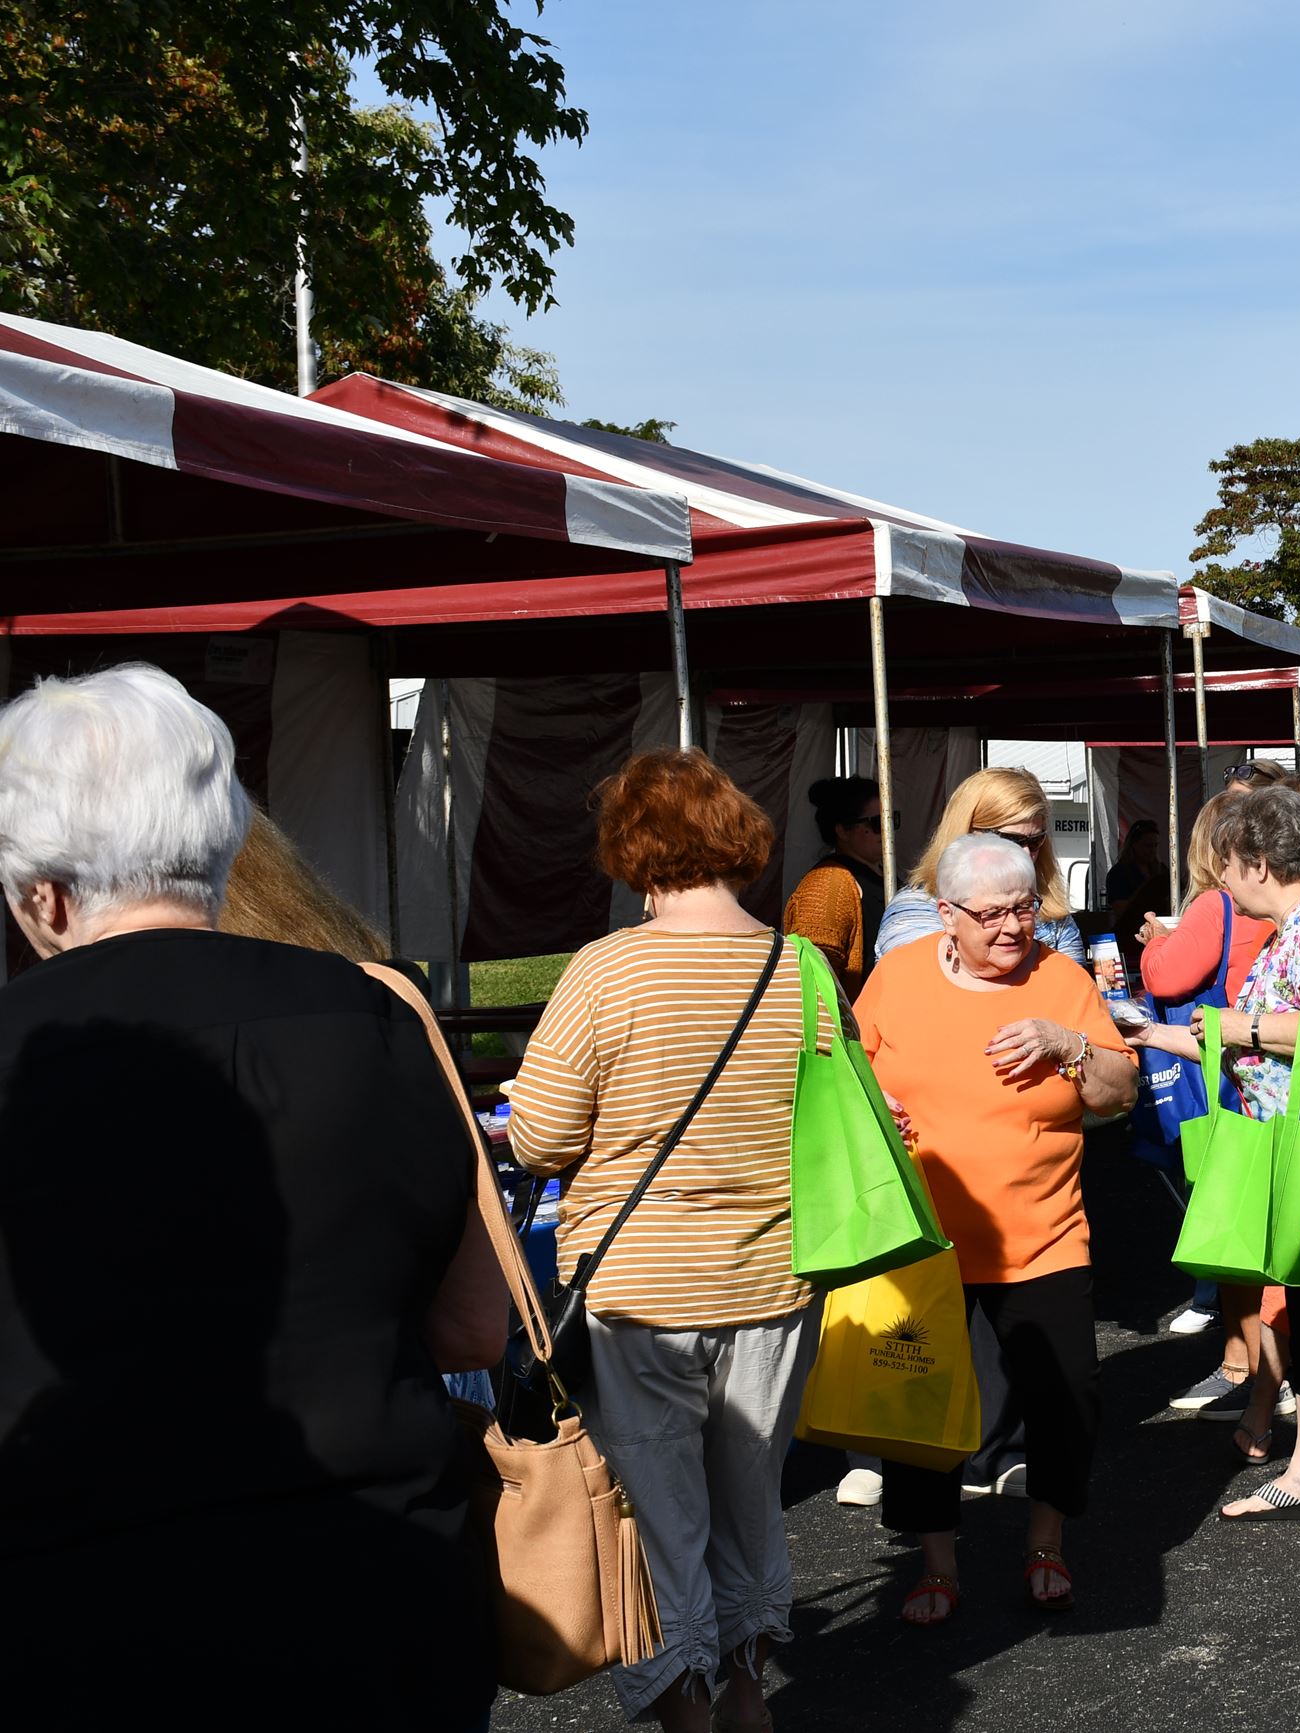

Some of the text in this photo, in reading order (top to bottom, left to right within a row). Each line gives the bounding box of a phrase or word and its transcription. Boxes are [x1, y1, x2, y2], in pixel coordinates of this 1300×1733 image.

[885, 1341, 921, 1355] STITH
[870, 1348, 935, 1365] FUNERAL HOMES
[873, 1358, 928, 1374] 859-525-1100
